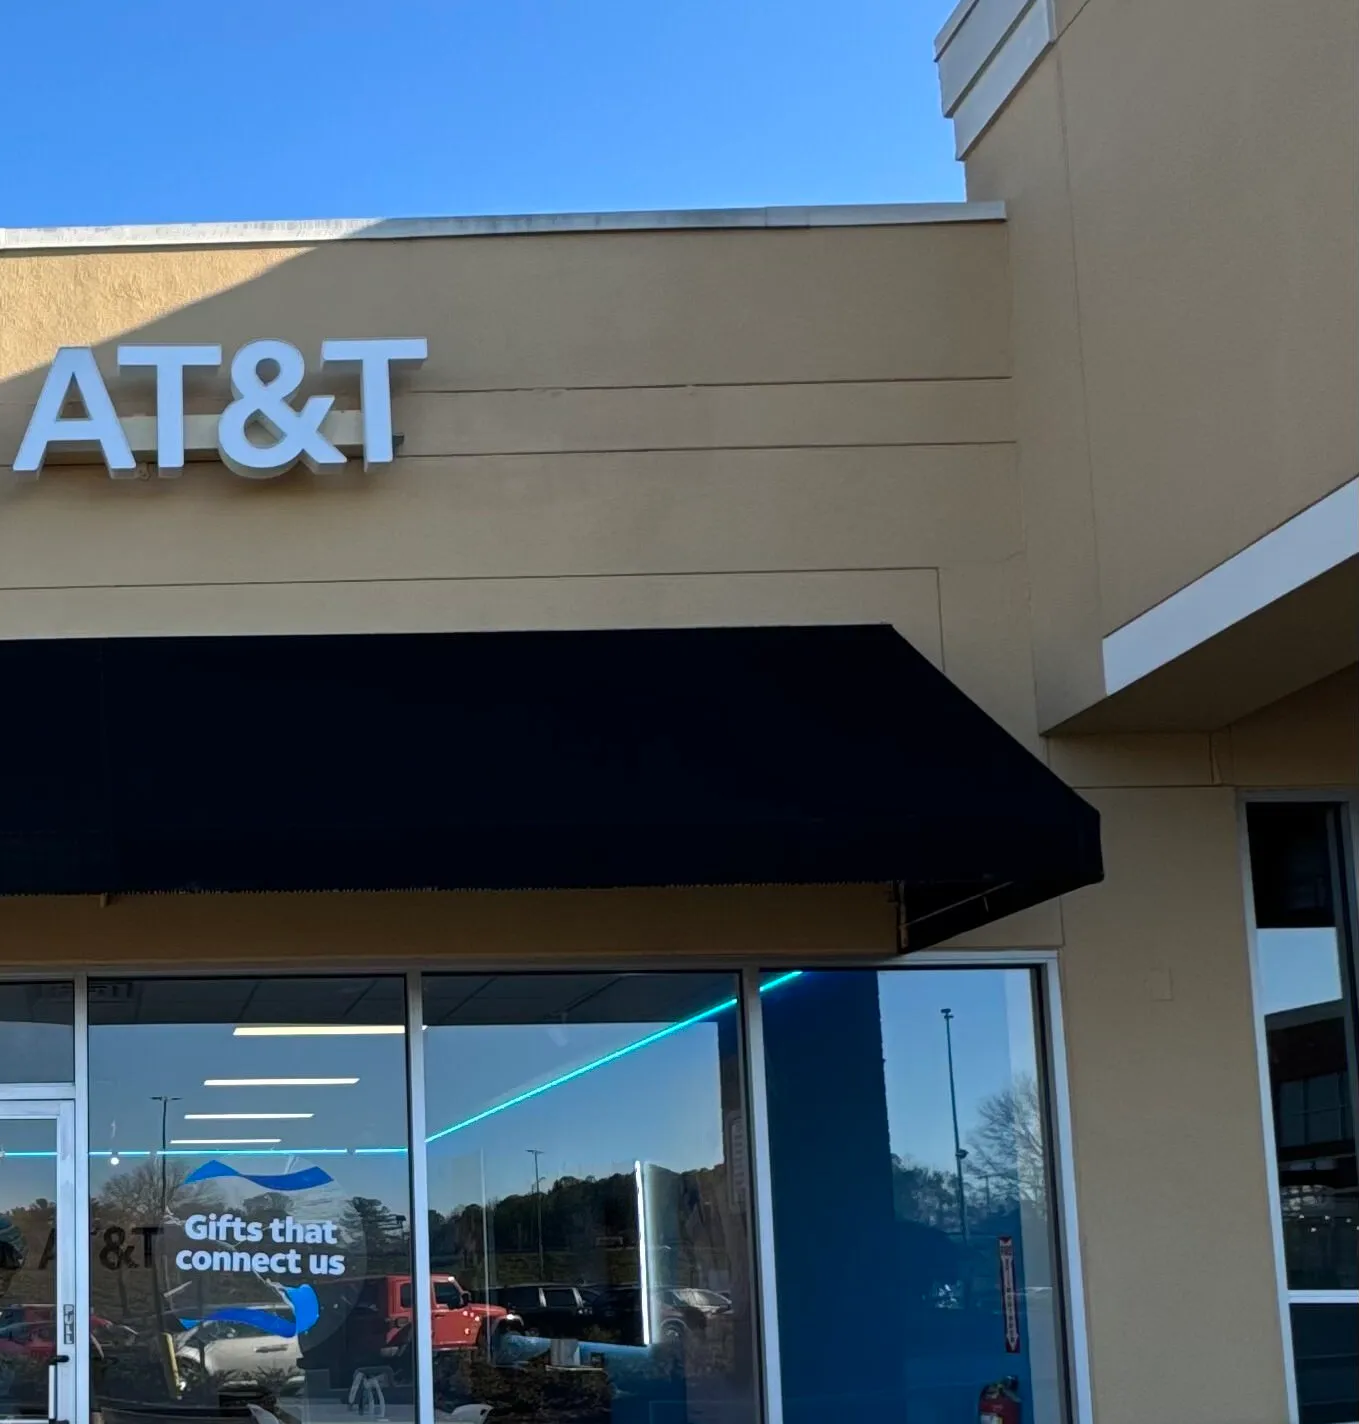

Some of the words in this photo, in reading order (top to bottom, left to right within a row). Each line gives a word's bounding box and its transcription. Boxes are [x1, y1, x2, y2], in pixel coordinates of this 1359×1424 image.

[12, 338, 428, 478] AT&T
[184, 1213, 263, 1242] Gifts
[270, 1217, 338, 1245] that
[175, 1248, 302, 1275] connect
[309, 1254, 346, 1277] us
[64, 1305, 74, 1344] PULL
